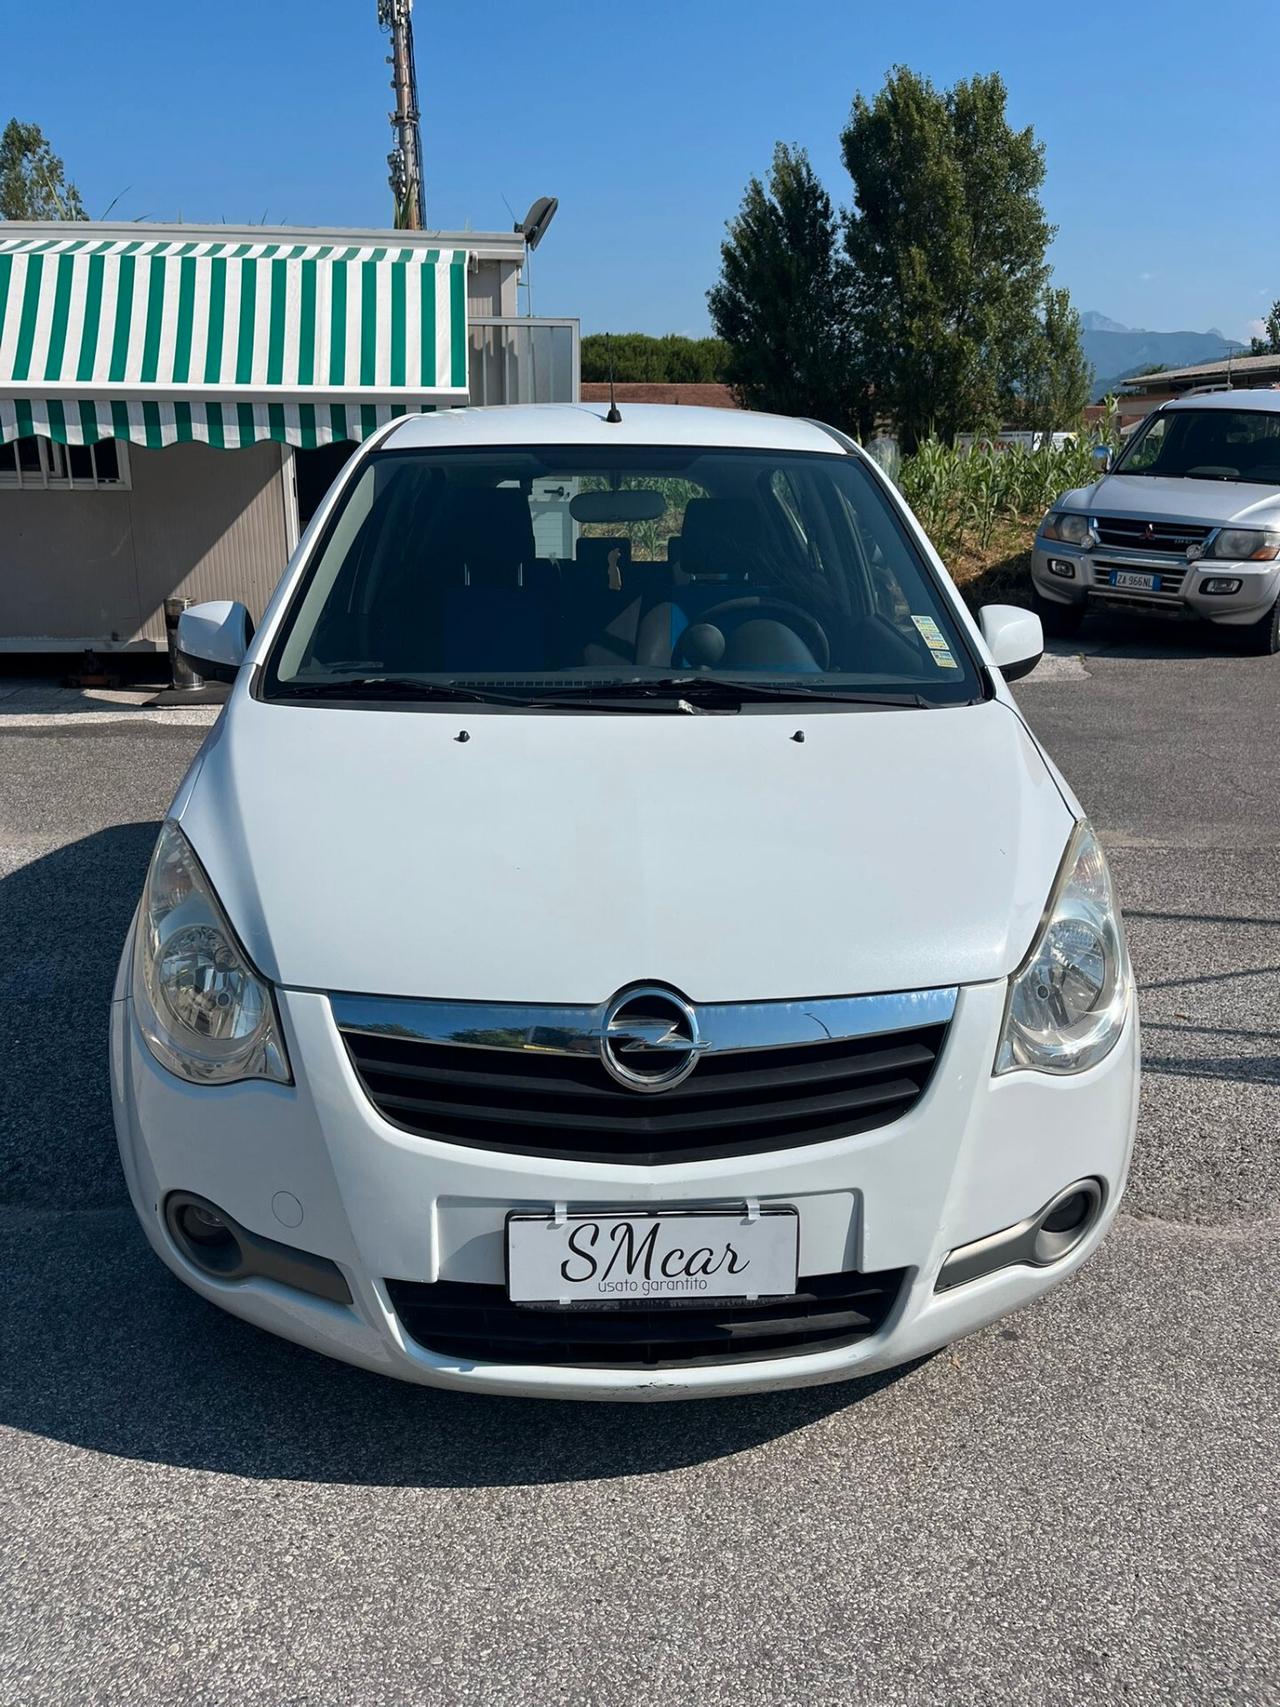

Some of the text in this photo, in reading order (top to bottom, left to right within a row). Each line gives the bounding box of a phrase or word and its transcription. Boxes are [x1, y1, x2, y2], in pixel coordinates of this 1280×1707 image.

[1117, 575, 1127, 585] ZA
[598, 1277, 708, 1296] usato garantito
